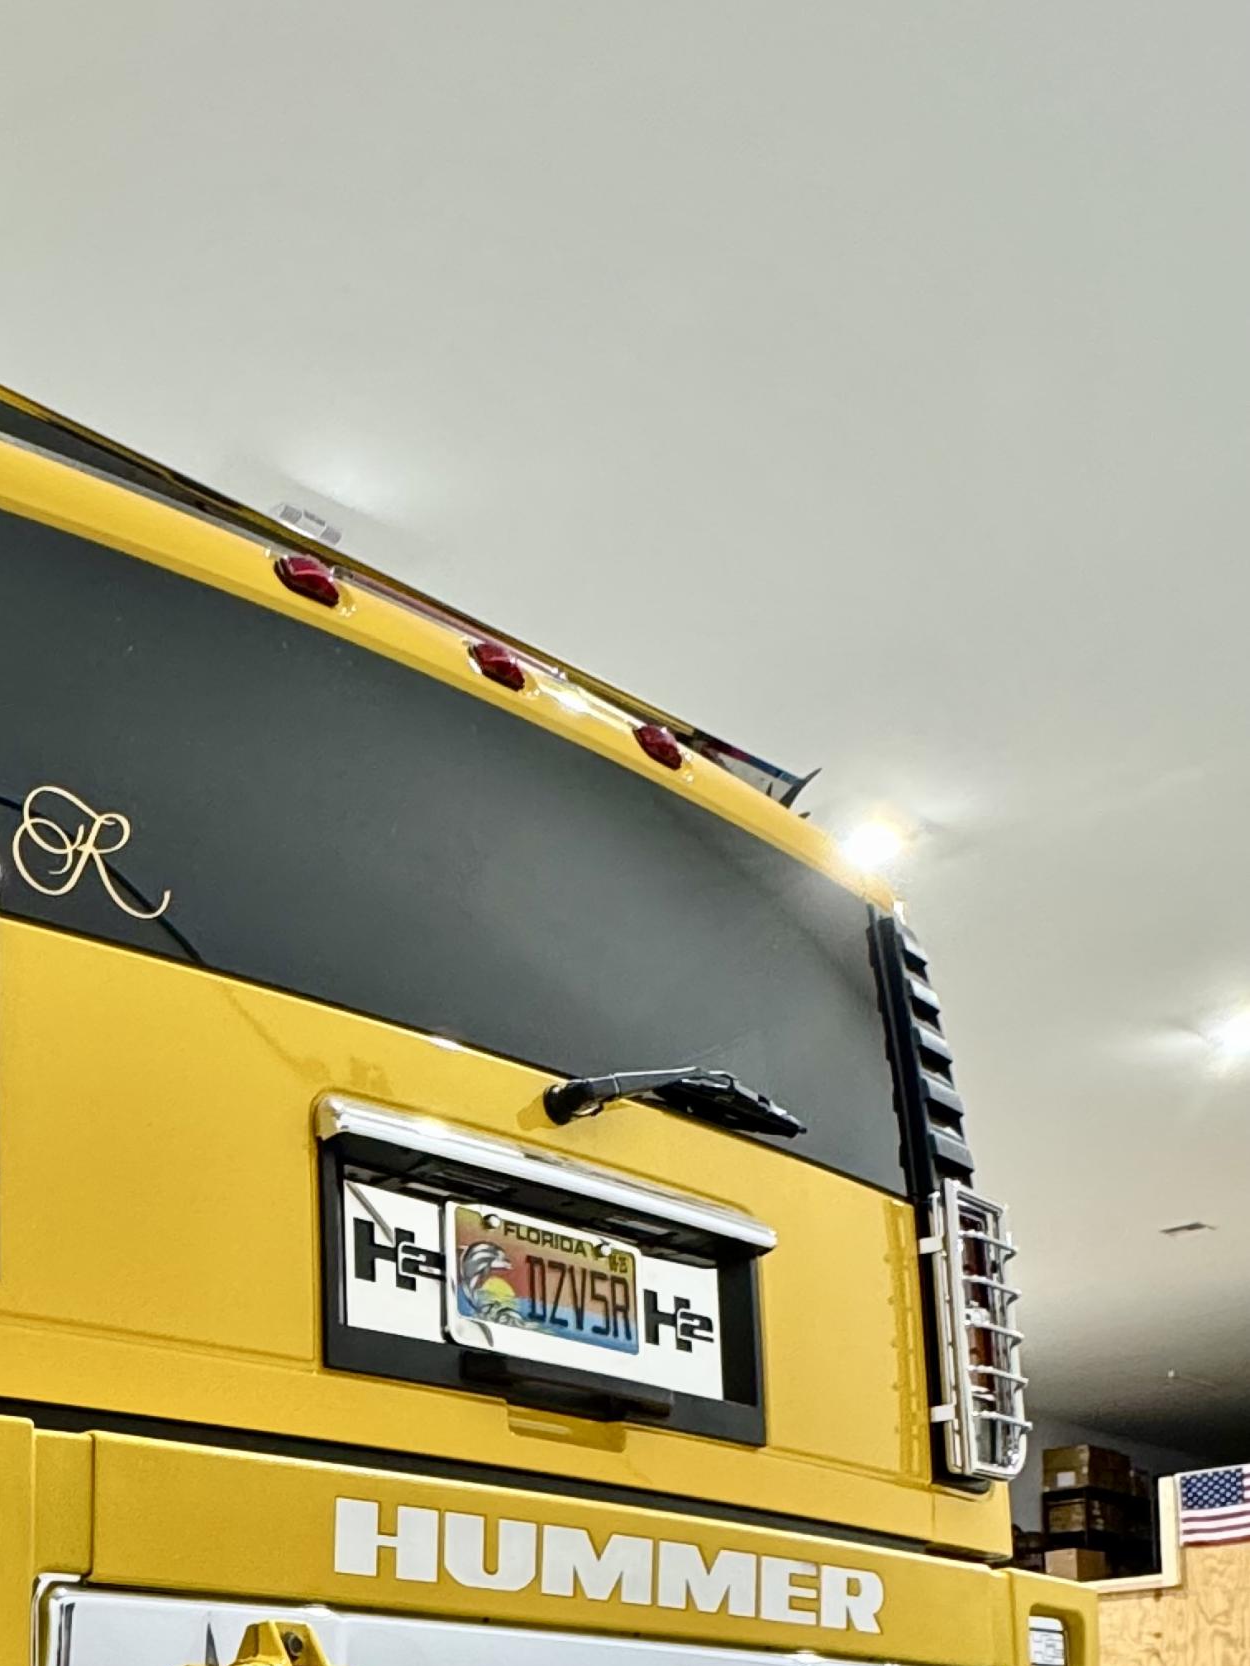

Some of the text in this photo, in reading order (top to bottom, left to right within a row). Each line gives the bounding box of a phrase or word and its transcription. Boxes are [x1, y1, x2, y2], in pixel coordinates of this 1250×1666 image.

[352, 1216, 447, 1292] H2
[503, 1220, 588, 1258] FLORIDA
[643, 1288, 715, 1354] H2
[333, 1496, 885, 1635] HUMMER
